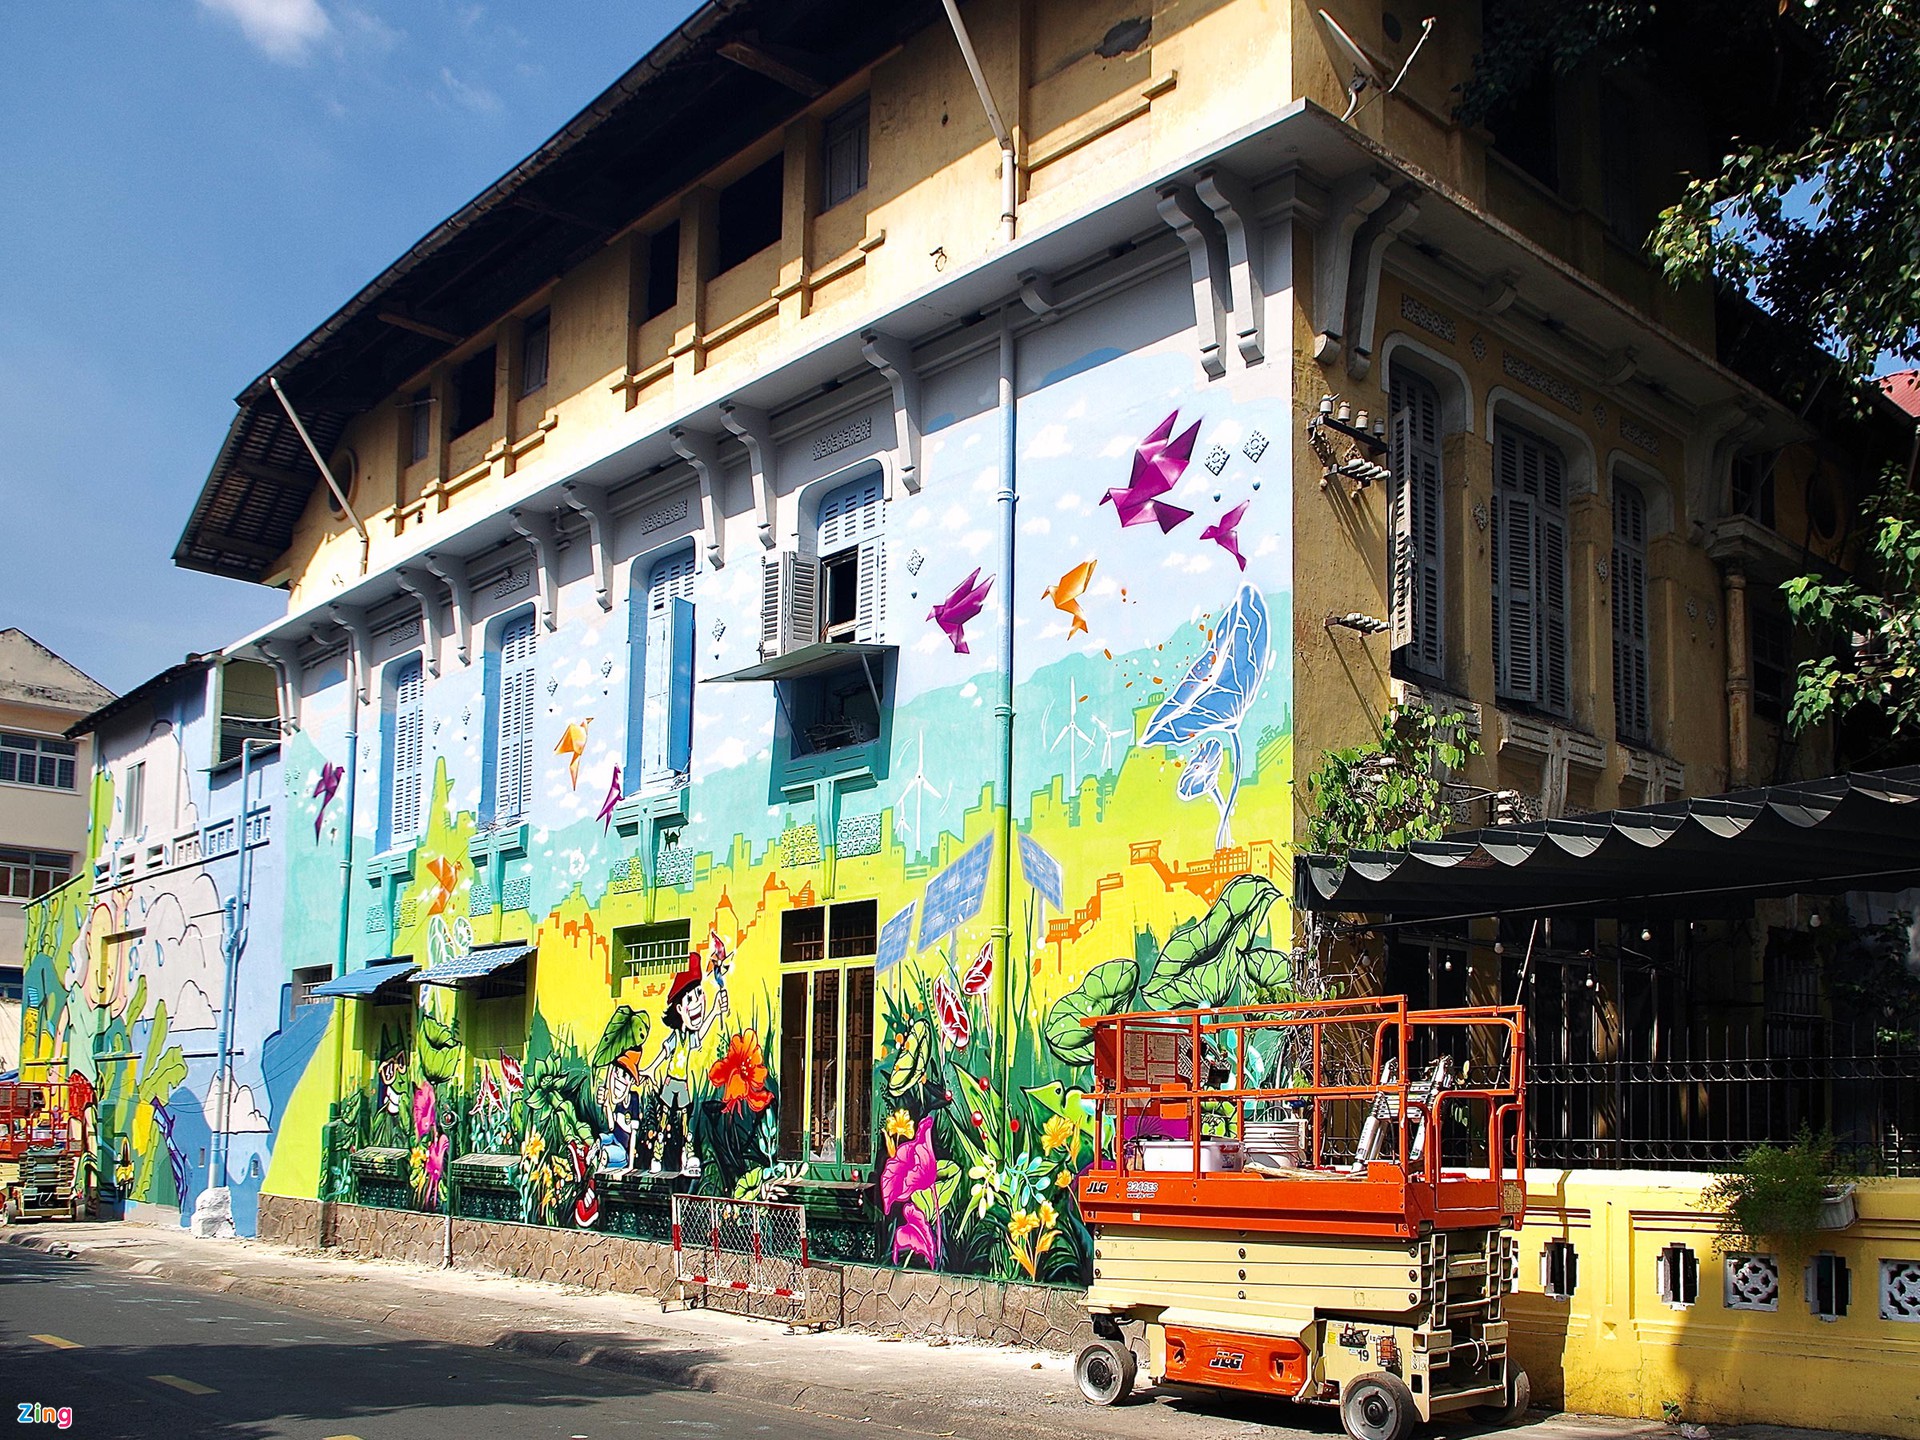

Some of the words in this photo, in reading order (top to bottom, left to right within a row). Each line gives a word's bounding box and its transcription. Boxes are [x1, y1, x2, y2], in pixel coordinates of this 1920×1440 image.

[1086, 1181, 1108, 1193] JLG
[1127, 1181, 1158, 1193] 3246ES
[1209, 1351, 1244, 1370] JLG
[1358, 1349, 1369, 1361] 19
